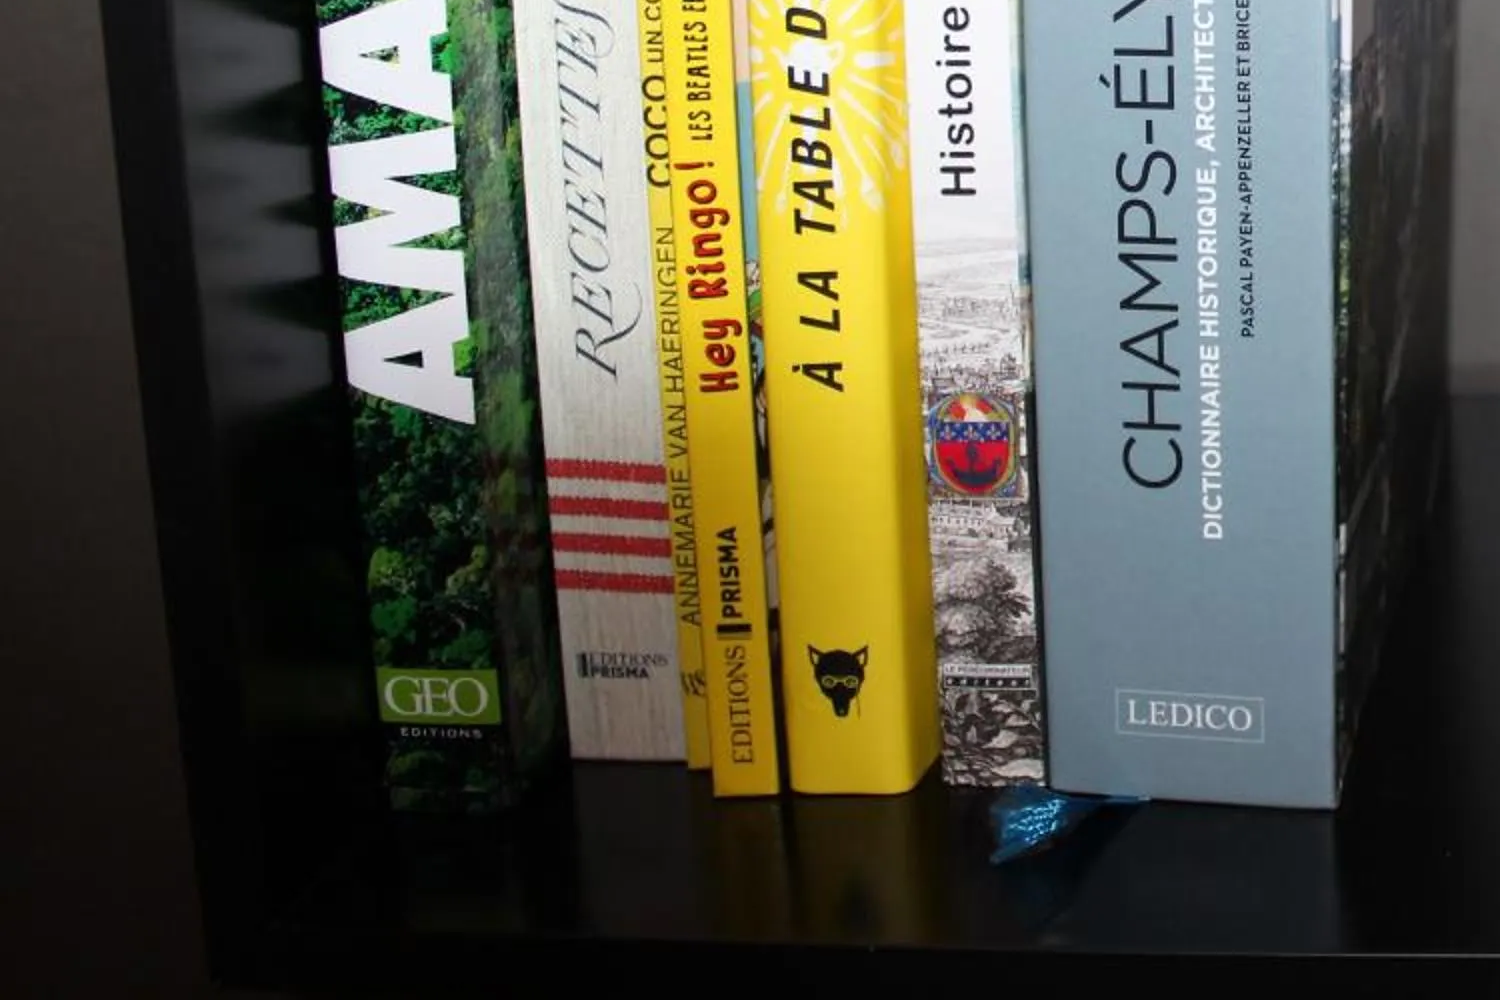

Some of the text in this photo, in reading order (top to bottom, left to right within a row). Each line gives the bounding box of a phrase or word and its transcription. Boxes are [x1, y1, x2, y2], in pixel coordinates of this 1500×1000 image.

[644, 30, 664, 63] UN
[1236, 0, 1251, 52] BRICE
[684, 20, 713, 102] BEATLES
[1236, 56, 1250, 76] ET
[641, 74, 671, 188] COCO
[688, 110, 713, 141] LES
[934, 5, 977, 197] Histoire
[787, 64, 837, 235] TABLE
[1236, 80, 1254, 267] PAYEN-APPENZELLER
[674, 161, 730, 301] Ringo!
[1196, 160, 1221, 337] HISTORIQUE,
[797, 270, 841, 333] LA
[1239, 272, 1255, 338] PASCAL
[700, 318, 743, 393] Hey
[792, 361, 845, 393] À
[655, 226, 702, 626] ANNEMARIE VAN HAERINGEN
[1199, 344, 1223, 540] DICTIONNAIRE
[589, 652, 669, 667] EDITIONS
[590, 666, 650, 680] PRISMA
[716, 526, 754, 764] EDITIONS PRISMA
[384, 676, 489, 717] GEO
[1127, 699, 1252, 731] LEDICO
[400, 727, 483, 739] EDITIONS
